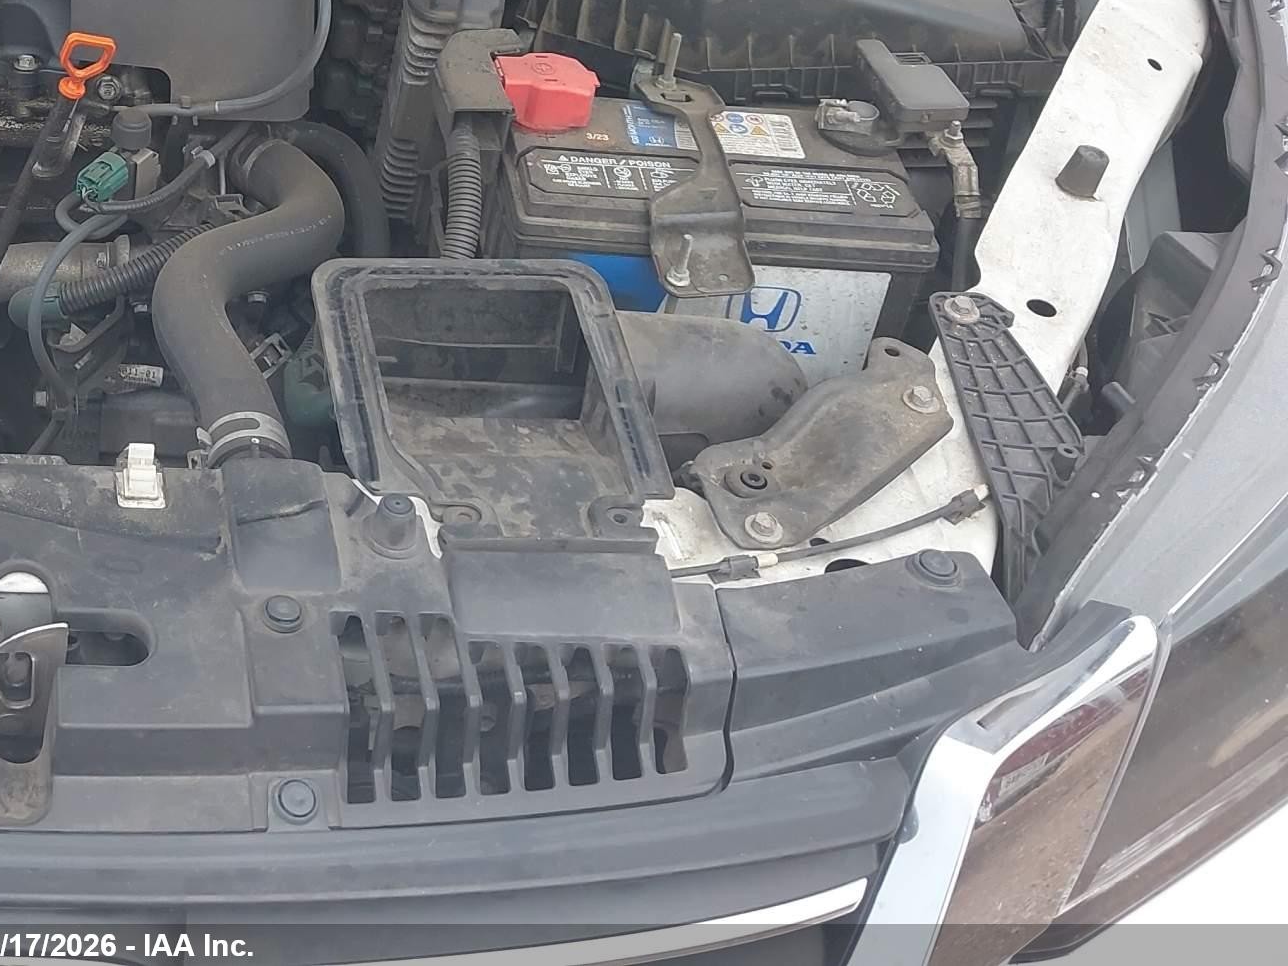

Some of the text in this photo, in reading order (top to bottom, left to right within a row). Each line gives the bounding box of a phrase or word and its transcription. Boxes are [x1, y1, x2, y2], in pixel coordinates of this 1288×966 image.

[586, 132, 610, 142] 3/23
[570, 155, 617, 166] DANGER
[628, 159, 672, 168] POISON
